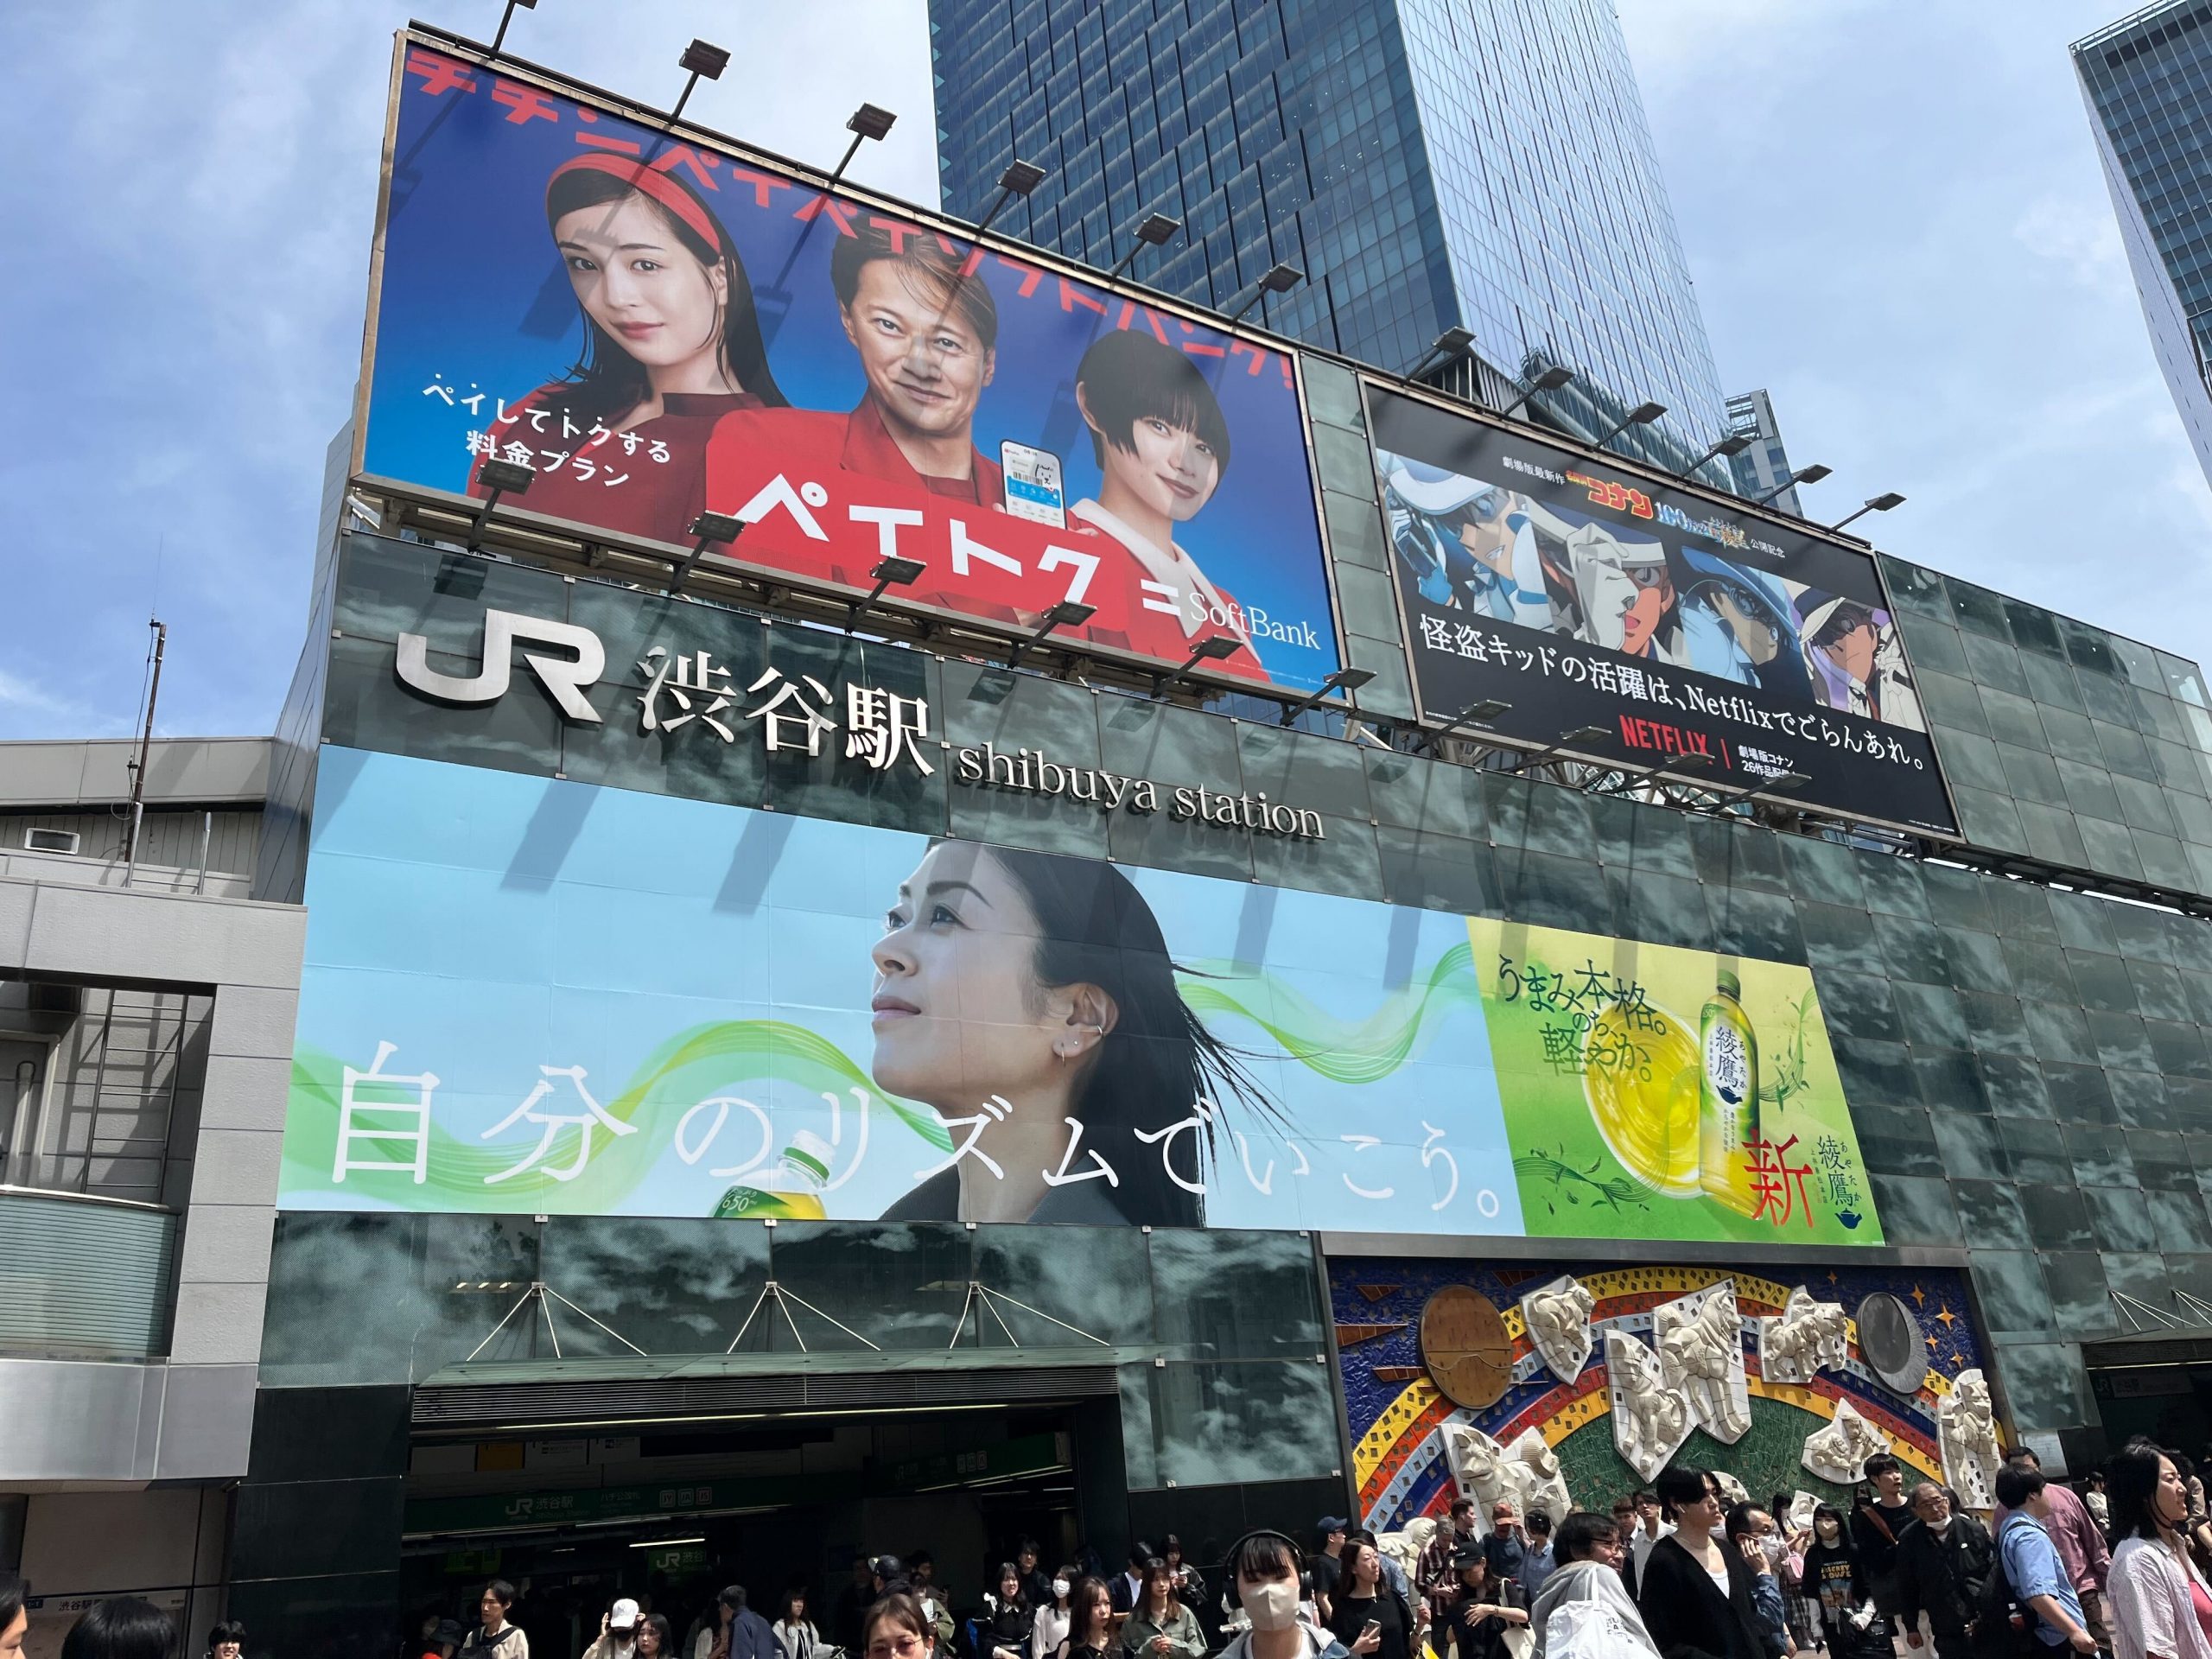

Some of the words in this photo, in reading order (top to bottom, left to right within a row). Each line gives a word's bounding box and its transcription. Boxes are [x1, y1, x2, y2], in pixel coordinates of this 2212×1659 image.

[423, 373, 671, 463] ペイしてトクする
[466, 430, 630, 486] 料金プラン
[733, 473, 1101, 605] ペイトク
[1190, 593, 1321, 651] SoftBank
[397, 608, 606, 724] JR
[636, 646, 935, 777] 渋谷駅
[1619, 715, 1713, 765] NETFLIX
[1738, 745, 1794, 767] 劇場版コナン
[1741, 760, 1796, 779] 26作品配
[958, 741, 1161, 811] shibuya
[1174, 783, 1327, 840] station
[1498, 954, 1667, 1035] うまみ本格。
[1539, 1021, 1652, 1084] 軽やか。
[1716, 1027, 1738, 1088] 綾鷹
[332, 1040, 1499, 1217] 自分のリズムでいこう。
[1741, 1128, 1814, 1229] 新
[1817, 1135, 1854, 1207] 綾鷹
[505, 1498, 533, 1516] JR
[657, 1553, 680, 1568] JR
